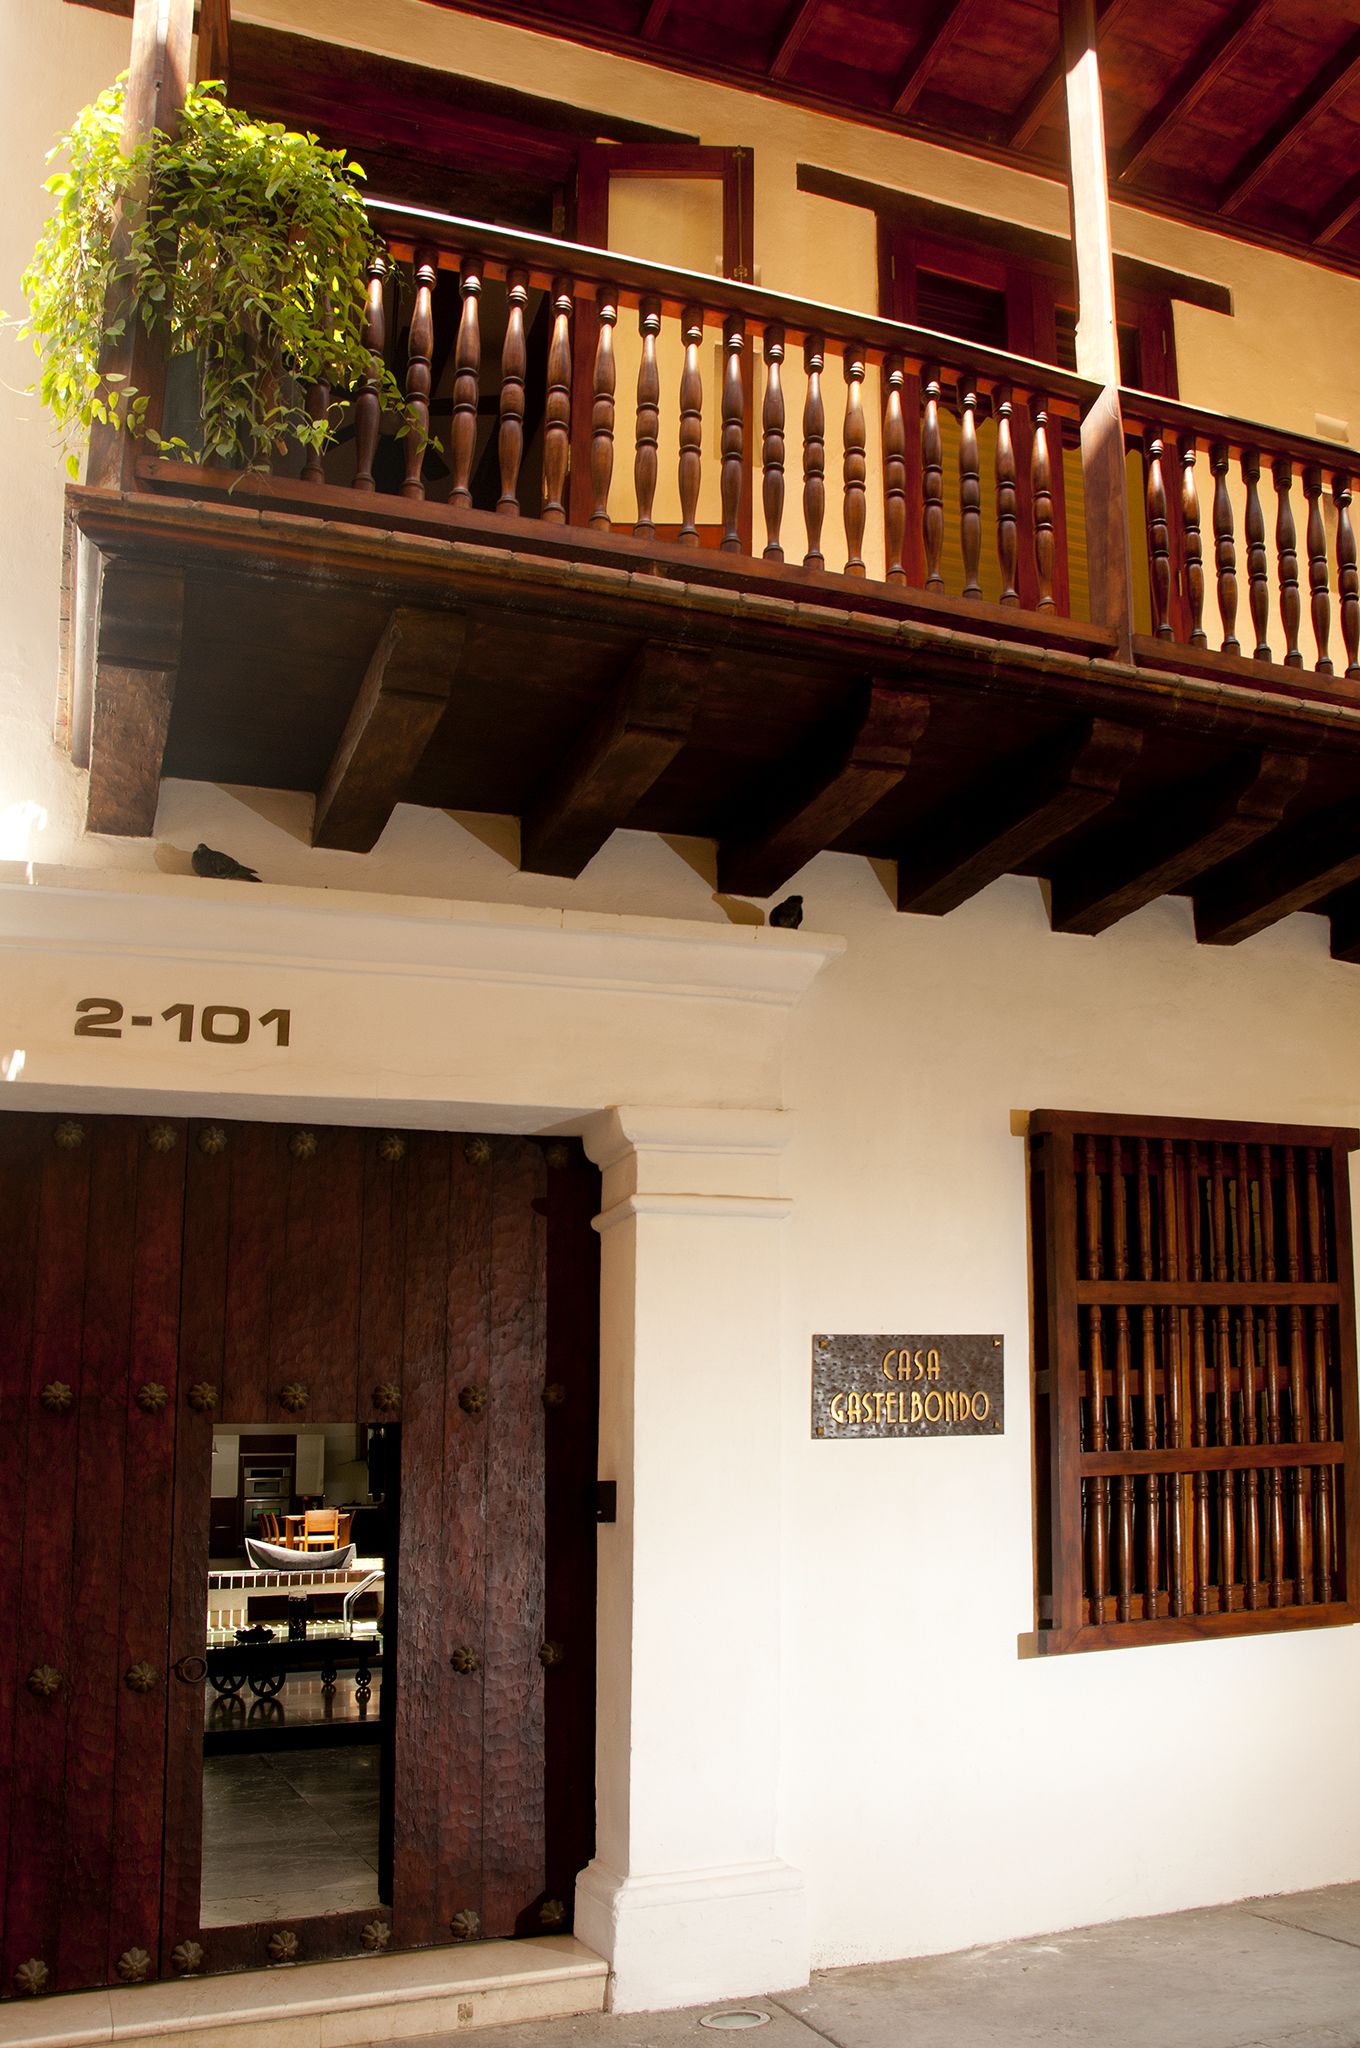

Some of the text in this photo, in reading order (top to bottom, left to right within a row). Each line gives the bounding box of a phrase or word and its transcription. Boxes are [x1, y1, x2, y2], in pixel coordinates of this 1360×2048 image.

[74, 997, 290, 1047] 2-101
[882, 1349, 941, 1381] CASA
[830, 1391, 991, 1424] GASTELBONDO
